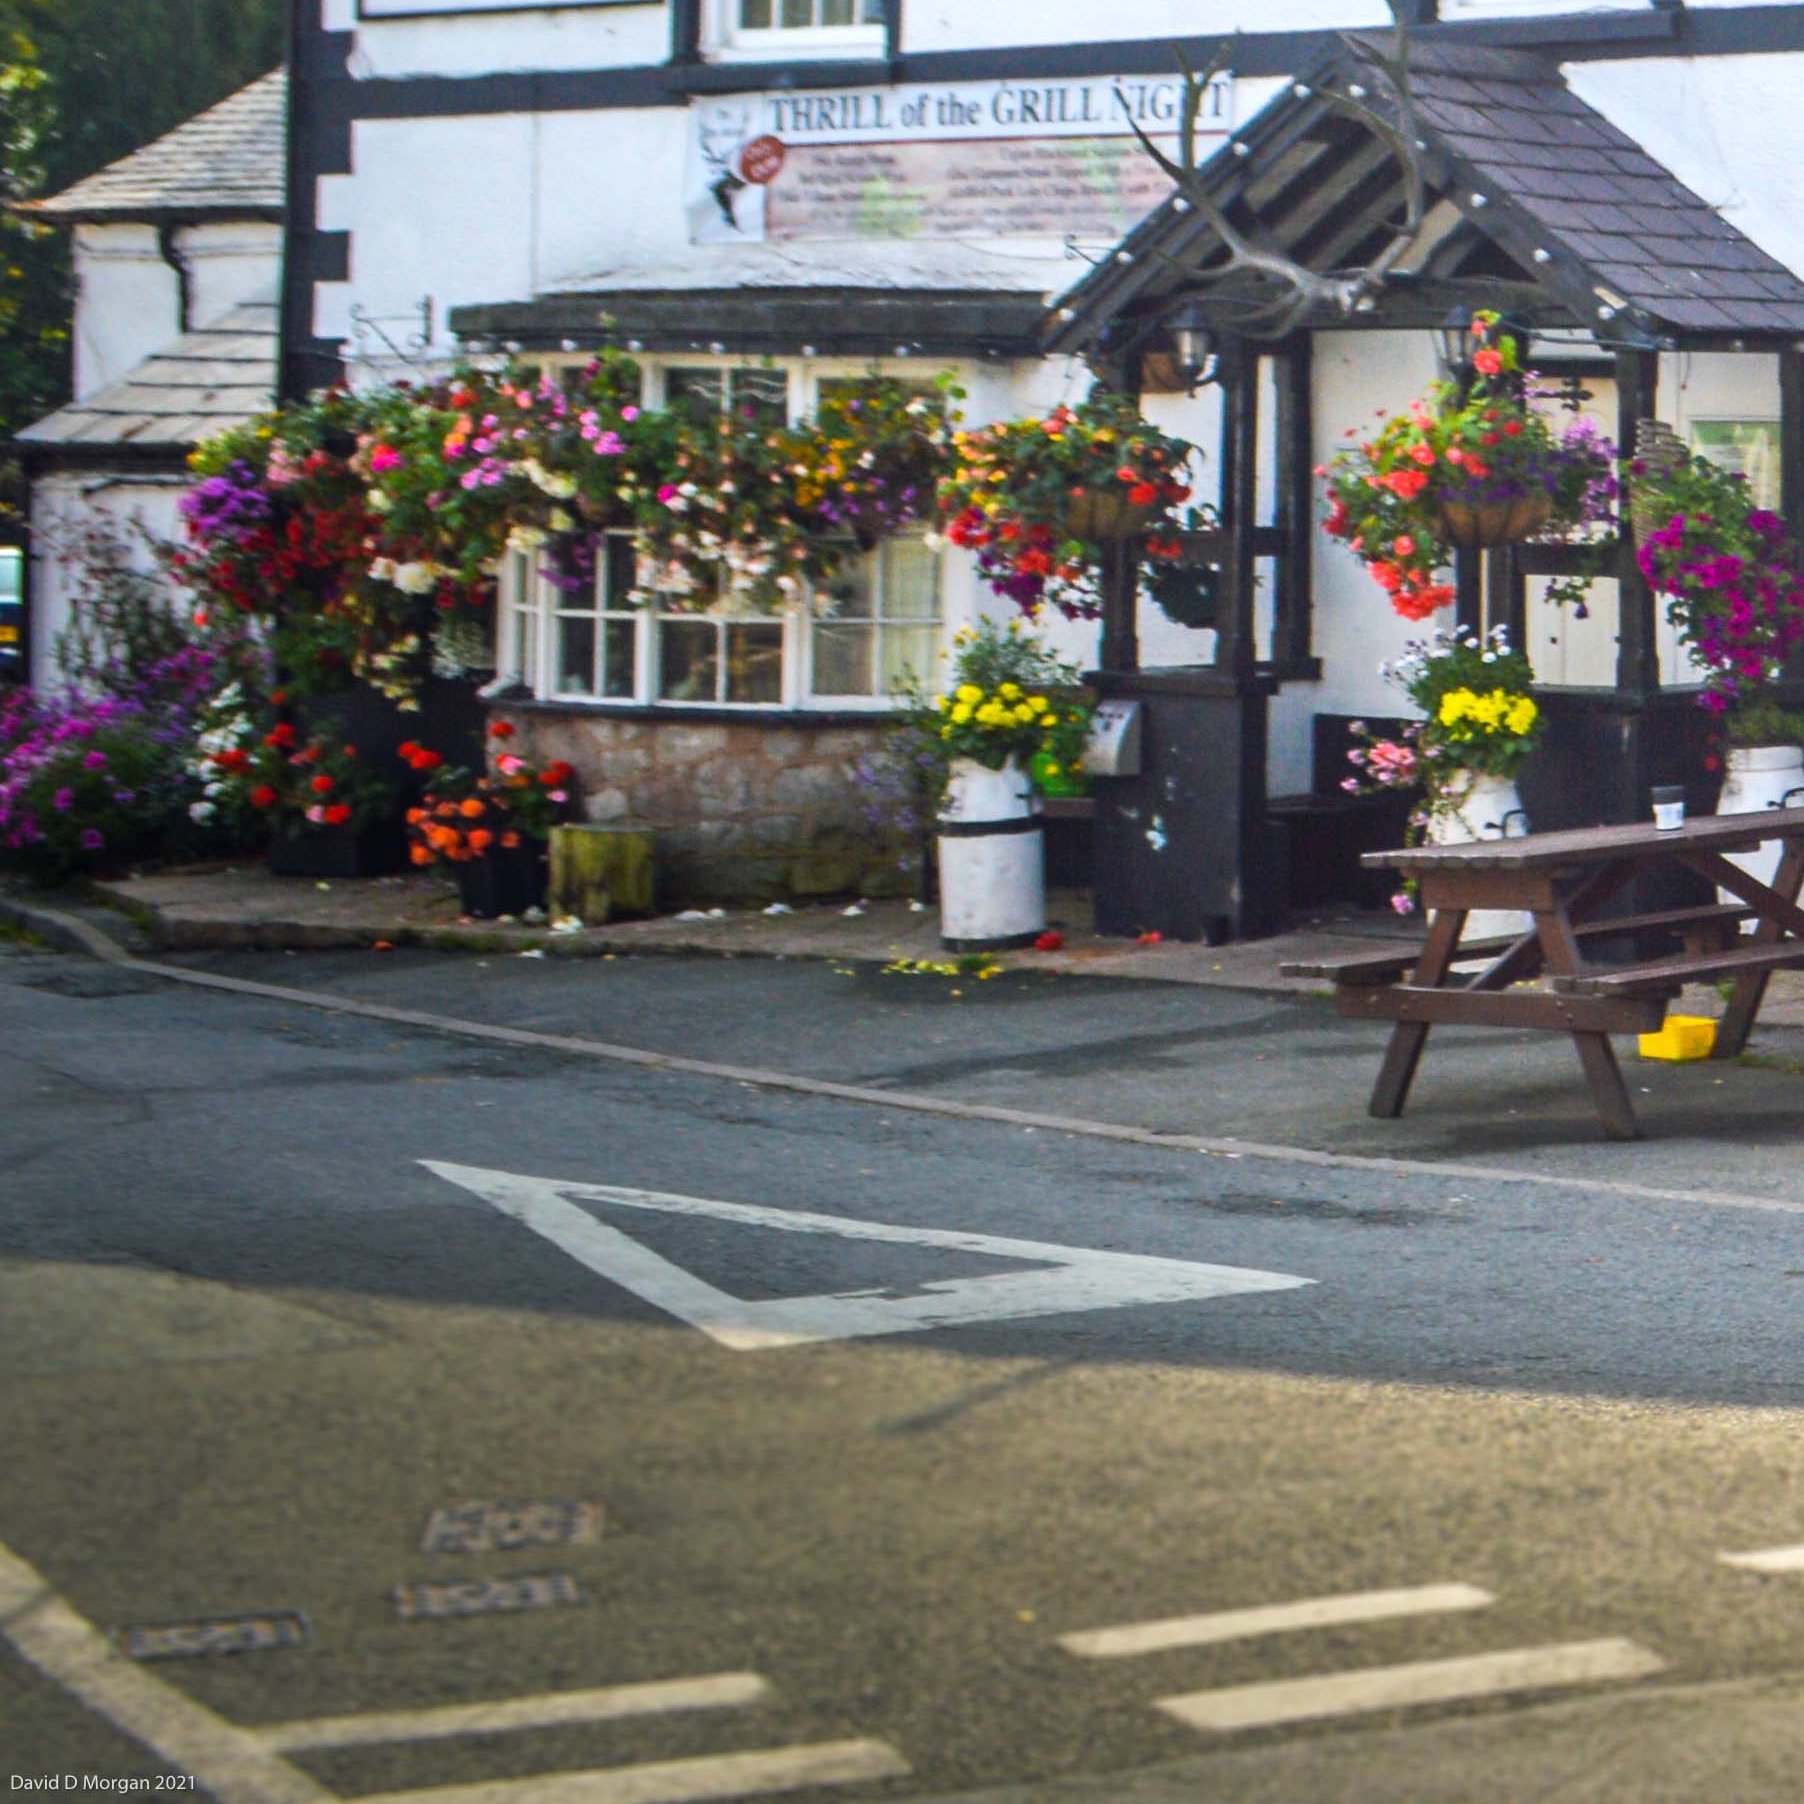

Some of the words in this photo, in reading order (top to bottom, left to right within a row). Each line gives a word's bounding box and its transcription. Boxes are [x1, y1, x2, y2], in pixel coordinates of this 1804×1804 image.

[769, 95, 891, 132] THRILL
[901, 93, 931, 127] of
[936, 92, 982, 126] the
[991, 83, 1101, 124] GRILL
[1111, 80, 1229, 122] NIGT
